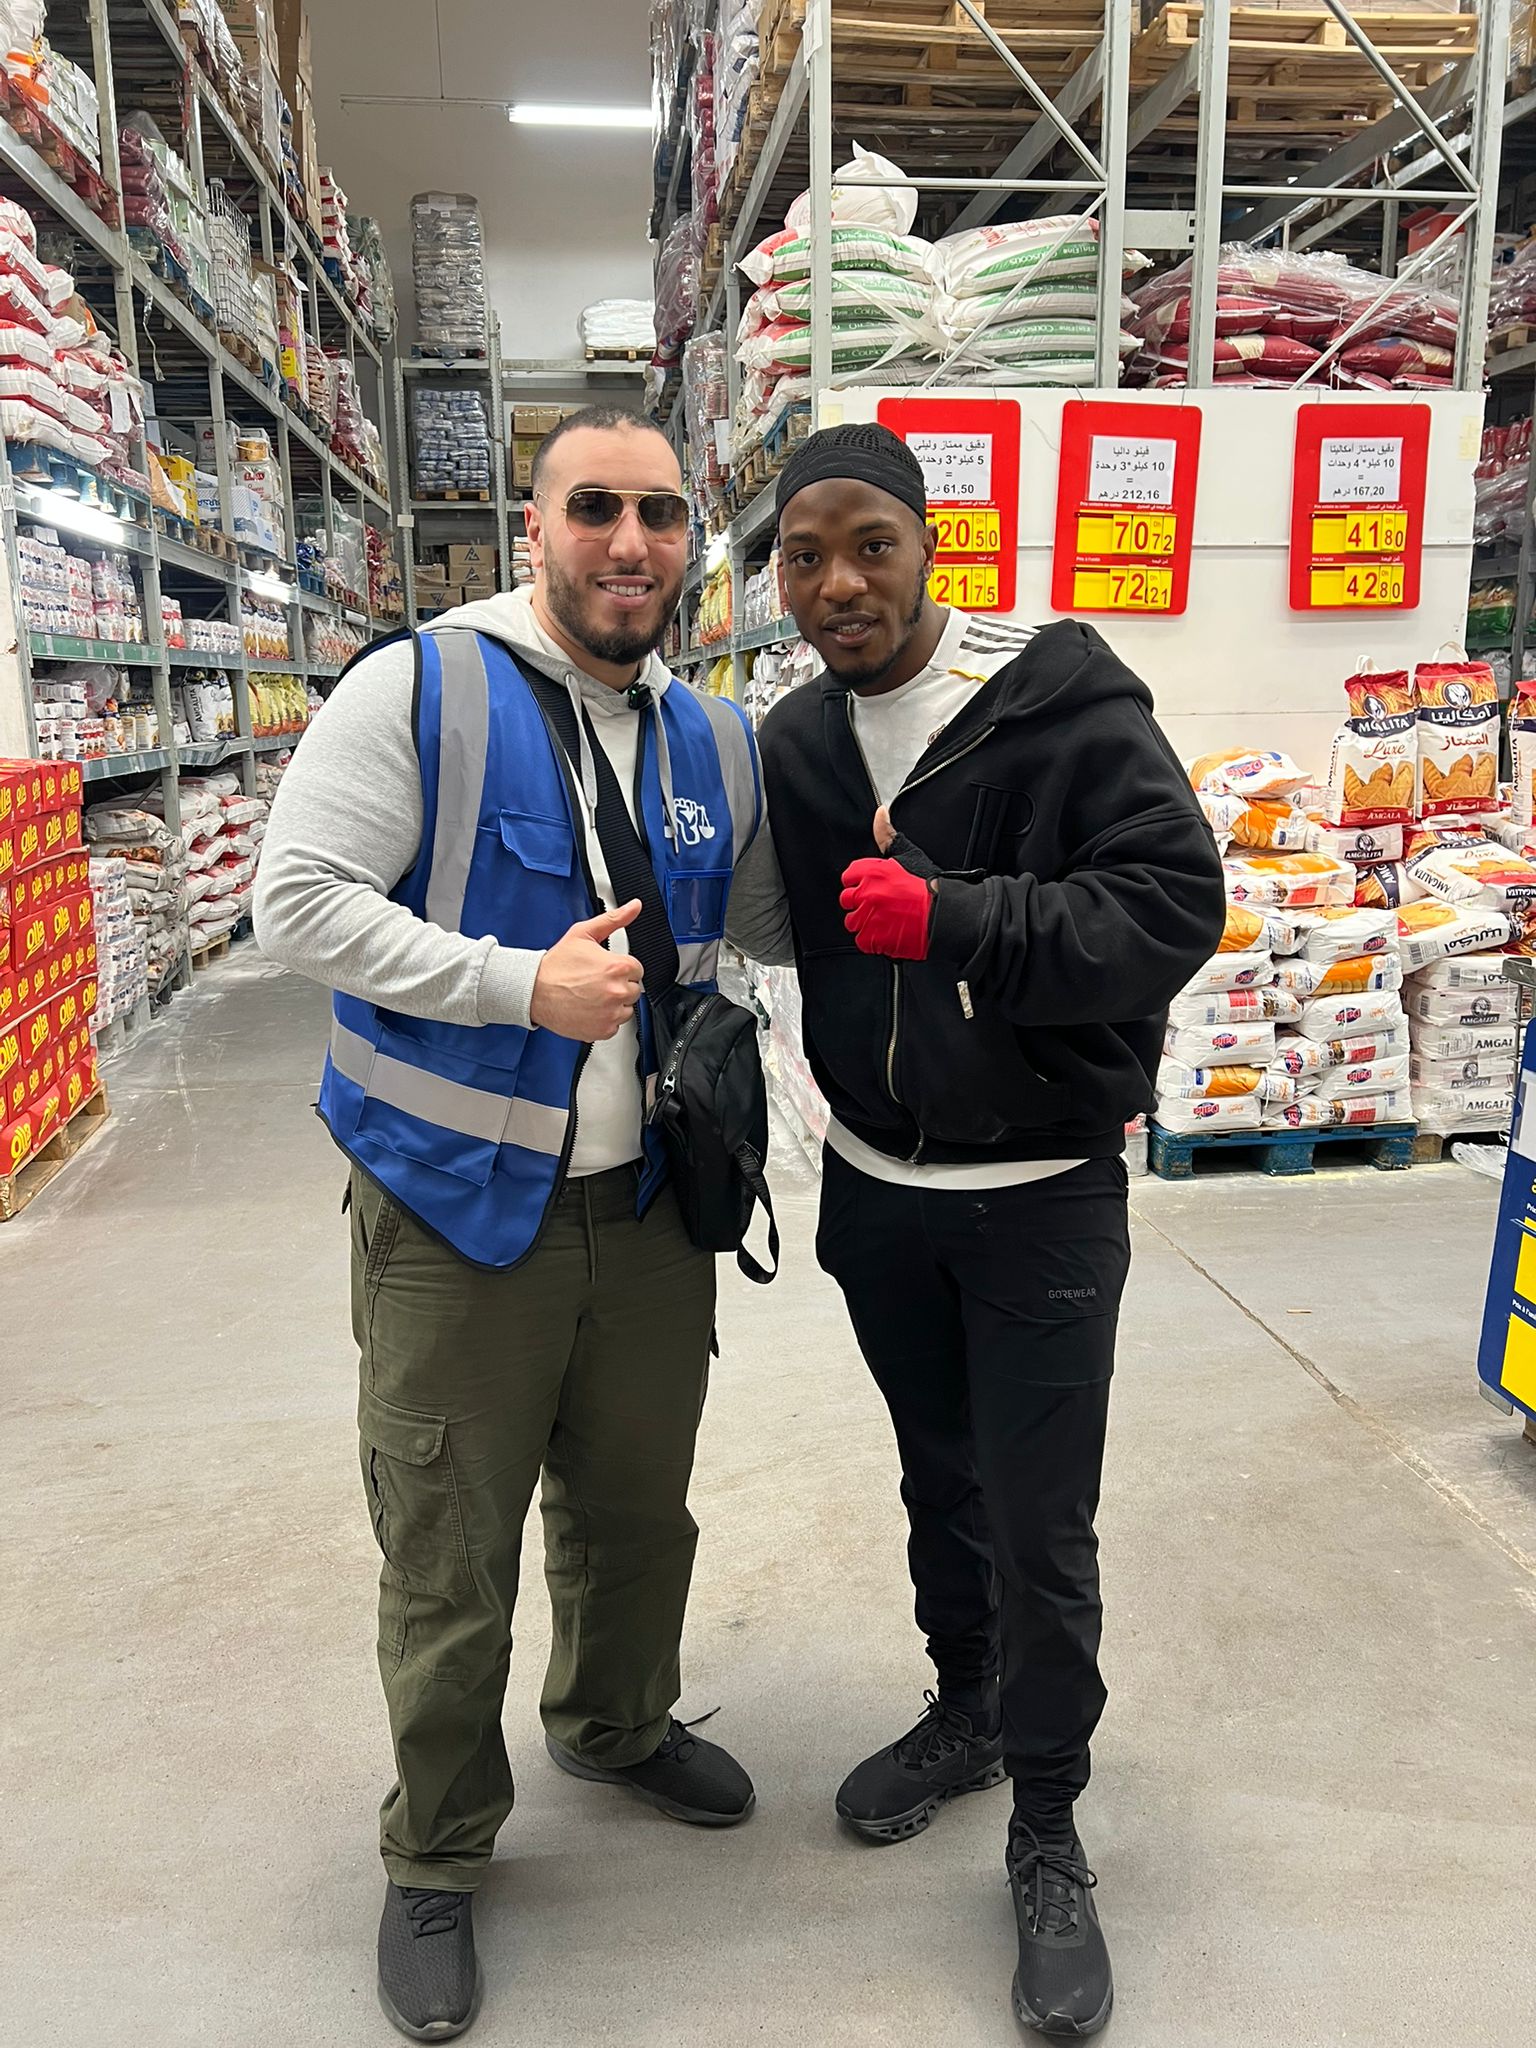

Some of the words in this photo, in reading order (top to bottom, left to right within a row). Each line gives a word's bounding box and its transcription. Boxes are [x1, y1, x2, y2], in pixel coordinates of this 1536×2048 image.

[977, 455, 984, 465] 5
[1328, 459, 1351, 469] وحدات
[1353, 459, 1359, 467] 4
[1384, 459, 1395, 468] 10
[1152, 462, 1165, 471] 10
[943, 484, 975, 494] 61,50
[1333, 487, 1351, 497] درهم
[1353, 486, 1385, 496] 167,20
[1099, 491, 1119, 500] درهم
[1122, 490, 1160, 500] 212,16
[1442, 734, 1489, 751] الممتاز
[1363, 740, 1406, 760] Luxe
[1345, 850, 1382, 859] AMGALITA
[1414, 868, 1453, 893] AMGALITA
[1212, 1034, 1237, 1046] Dalia
[1346, 1068, 1372, 1082] Dalia
[1193, 1103, 1219, 1115] Dalia
[1048, 1287, 1097, 1299] GOREWEAR
